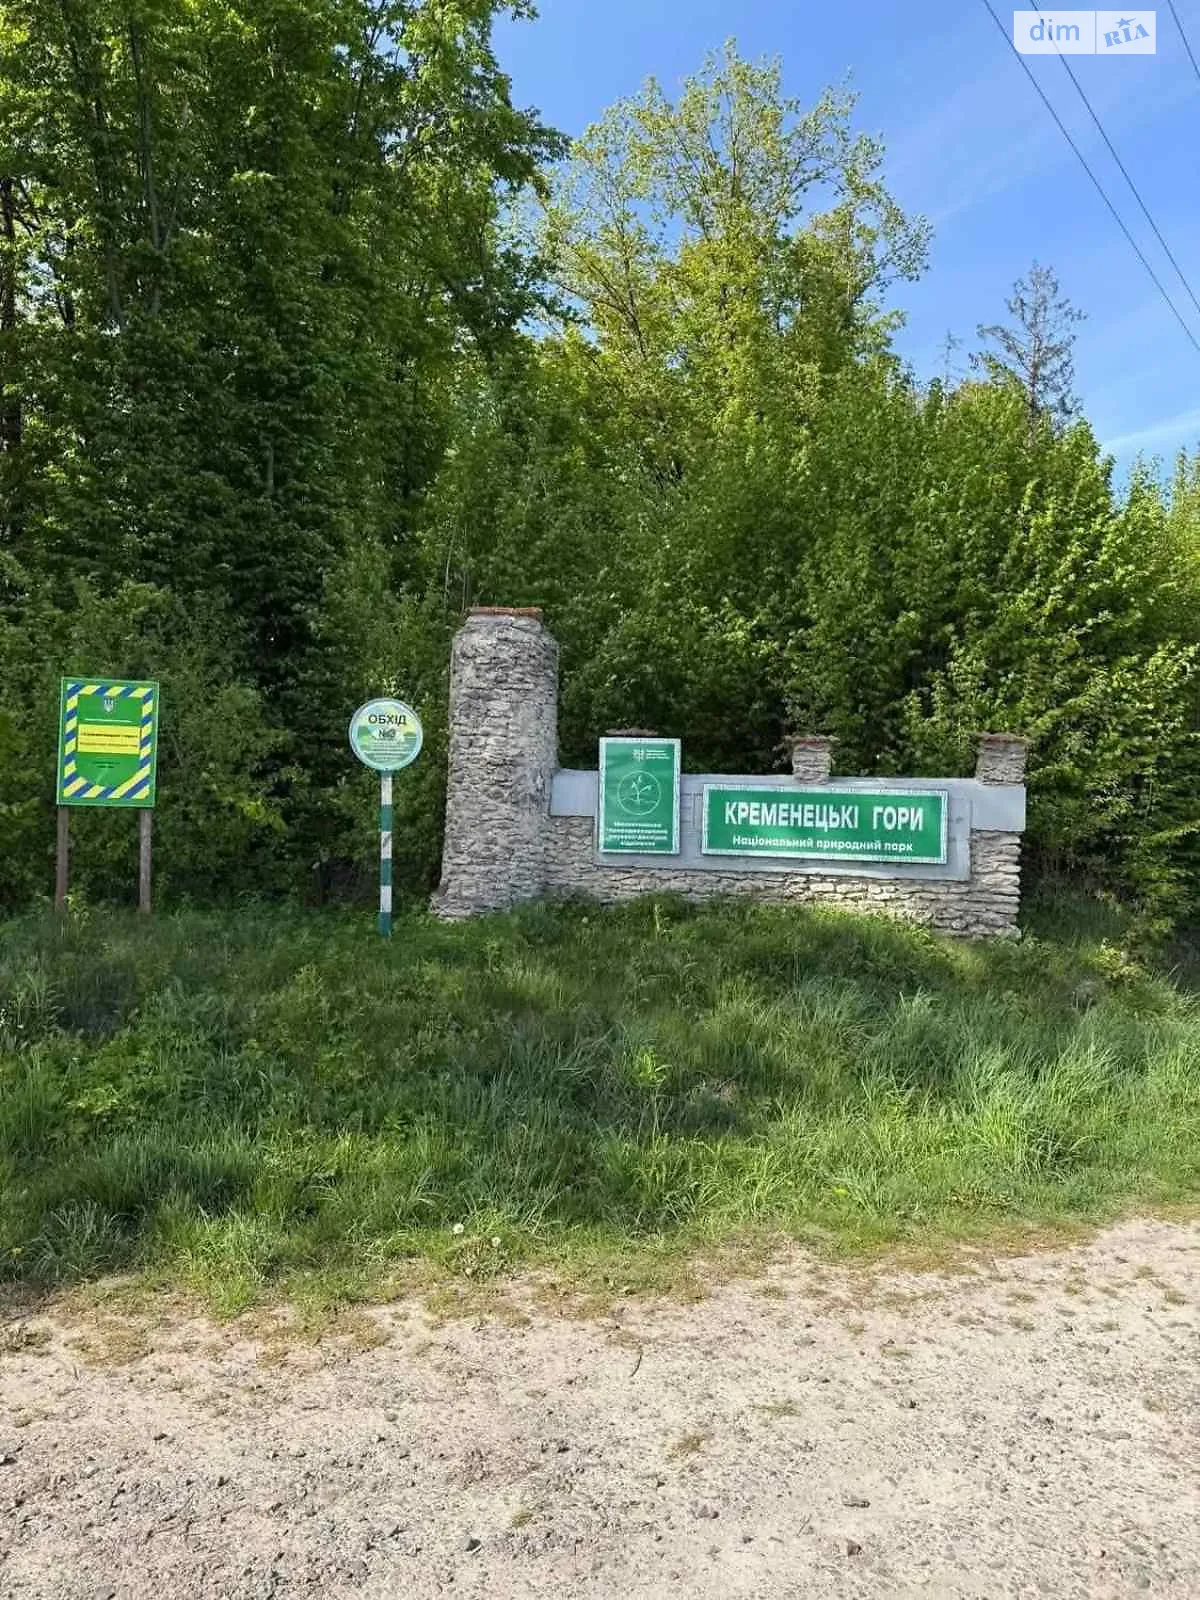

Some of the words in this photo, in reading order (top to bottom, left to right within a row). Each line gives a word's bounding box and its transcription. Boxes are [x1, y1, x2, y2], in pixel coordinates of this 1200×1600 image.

[368, 714, 407, 727] ОБХІД
[724, 801, 859, 832] КРЕМЕНЕЦЬКІ
[872, 806, 924, 831] ГОРИ
[733, 835, 814, 848] Національний
[816, 838, 881, 851] природний
[884, 842, 913, 852] парк
